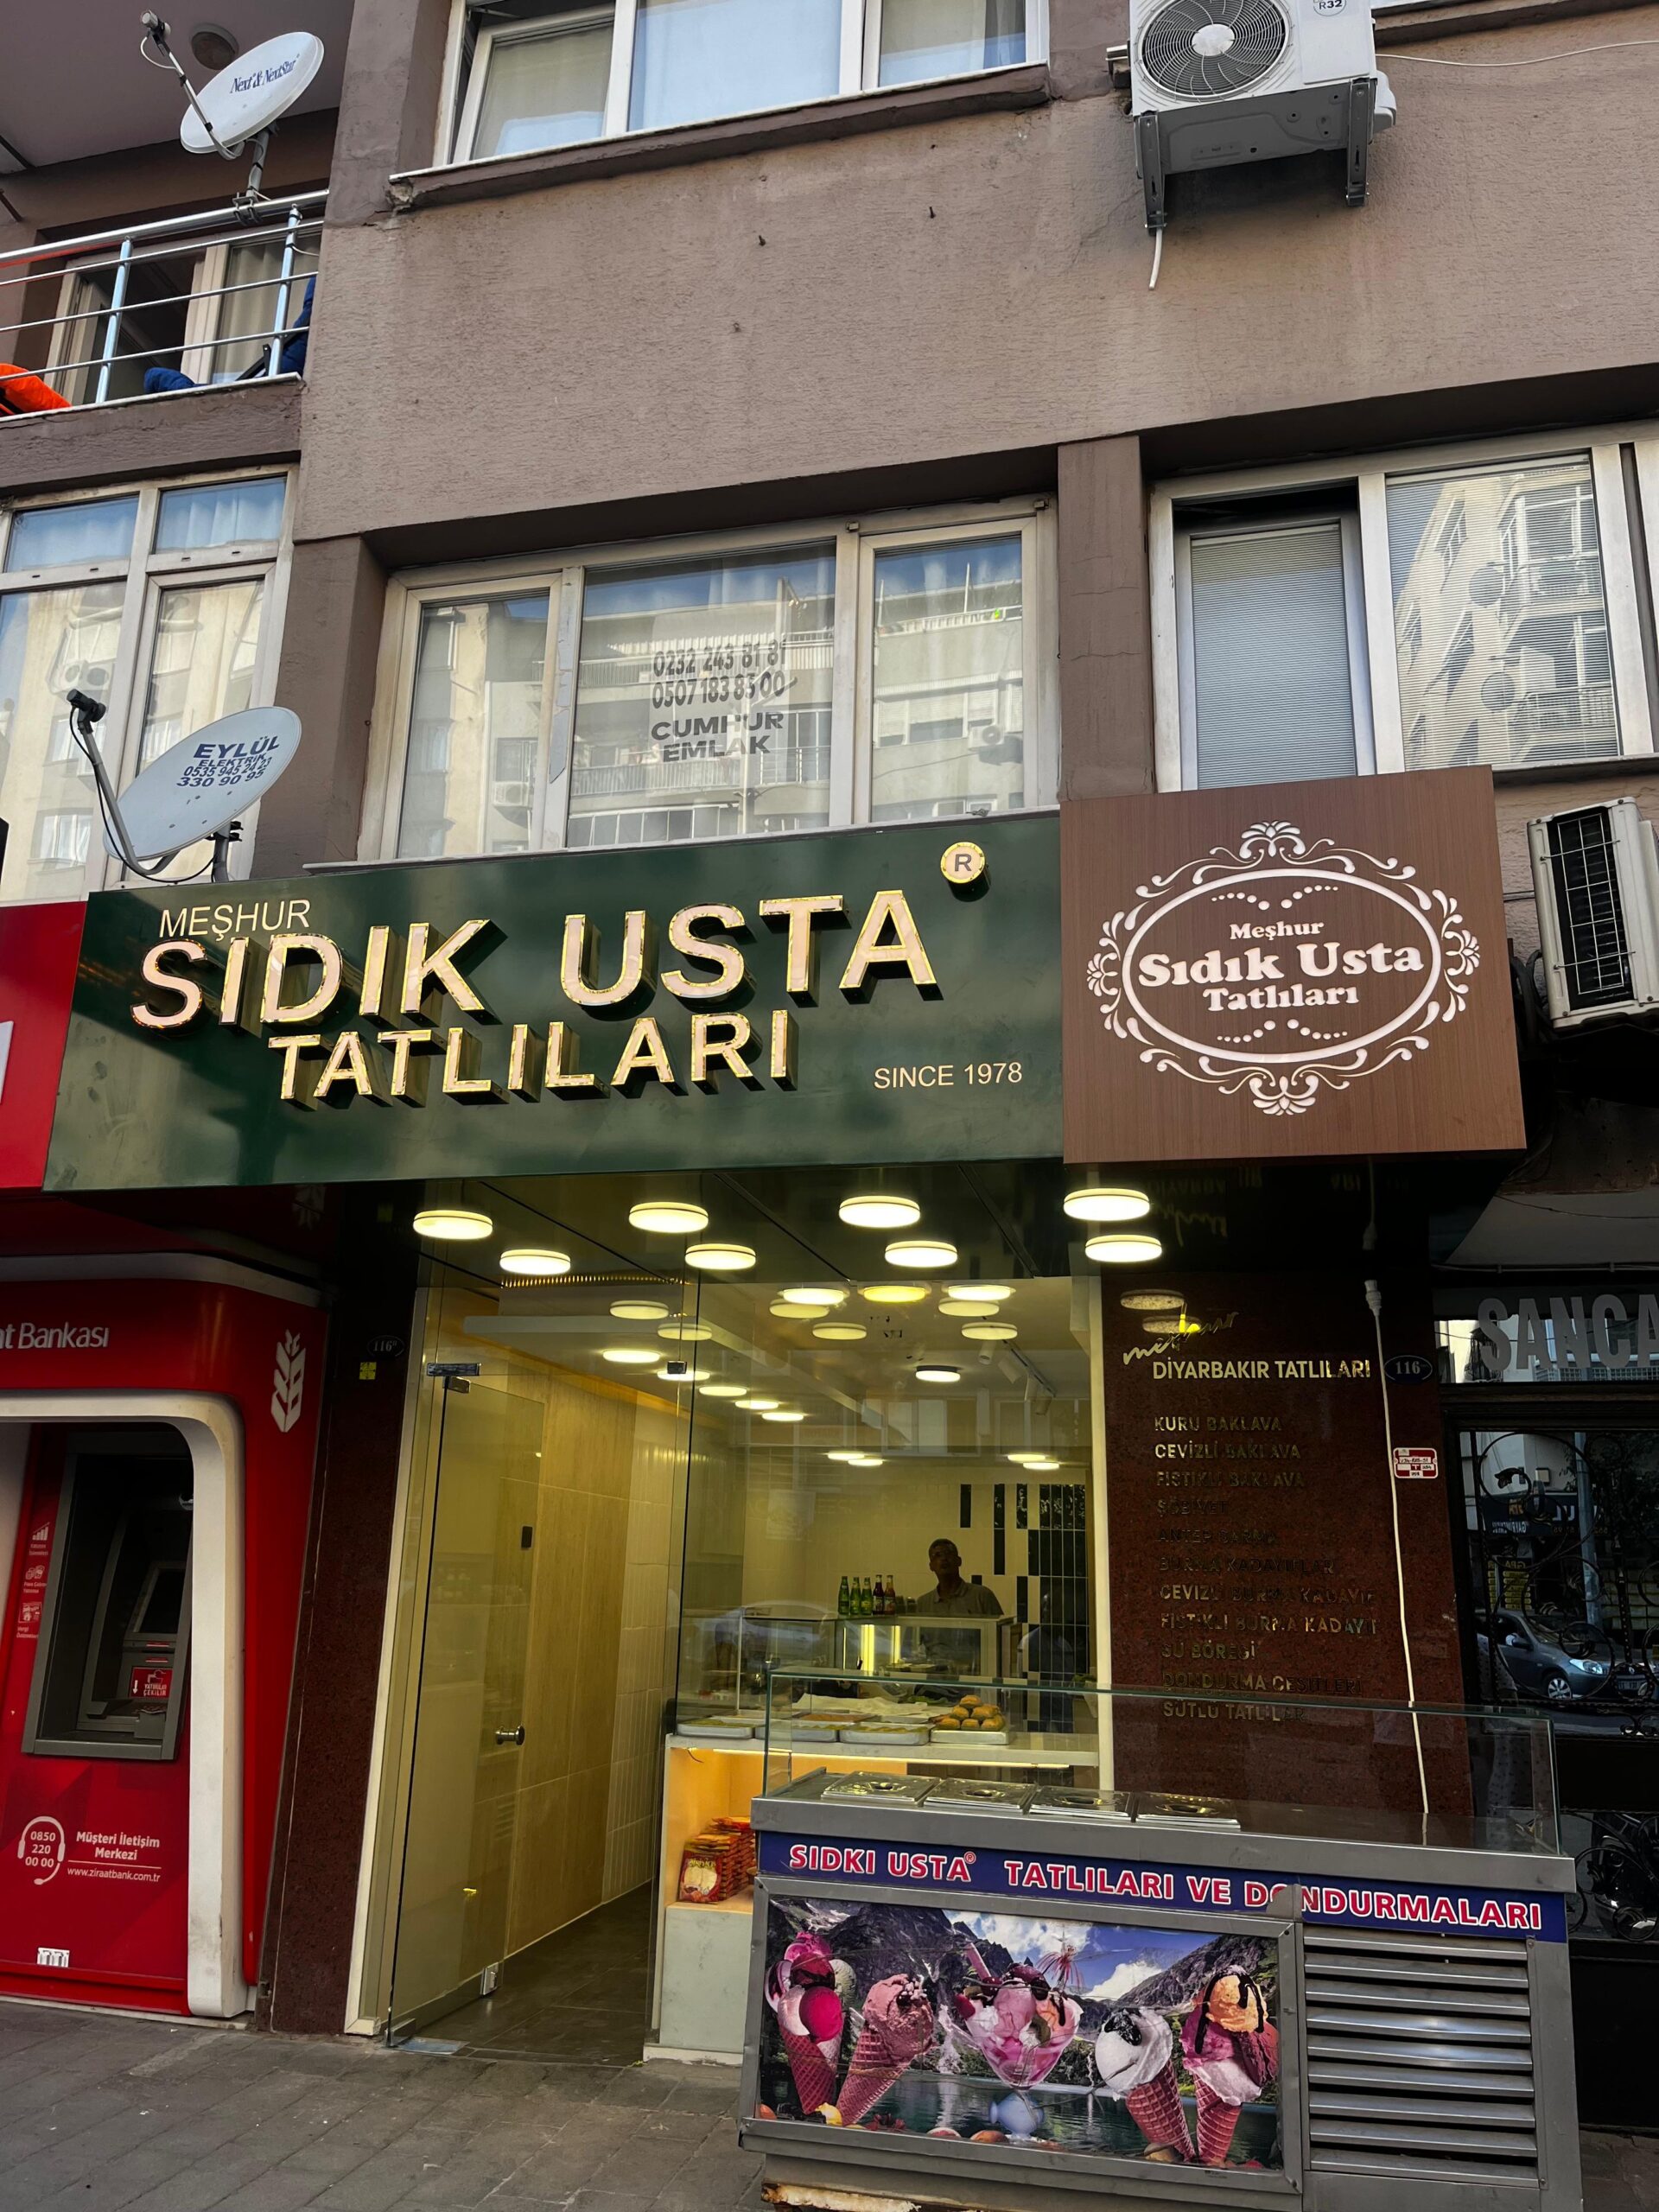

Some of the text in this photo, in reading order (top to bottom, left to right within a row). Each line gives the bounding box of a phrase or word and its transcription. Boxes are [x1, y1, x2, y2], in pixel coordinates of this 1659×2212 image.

[653, 647, 696, 677] 0232
[652, 678, 697, 709] 0507
[700, 676, 729, 703] 183
[760, 671, 785, 698] 00
[194, 736, 279, 758] EYLÜL
[663, 735, 771, 763] EMLAK
[176, 768, 264, 787] 330 90 95
[184, 766, 217, 777] 0535
[218, 766, 239, 776] 945
[241, 763, 256, 773] 24
[159, 899, 311, 942] MEŞHUR
[1229, 921, 1325, 941] Meşhur
[130, 919, 491, 1028] SIDIK
[560, 890, 938, 1006] USTA
[1138, 942, 1425, 987] Sıdık Usta
[1202, 983, 1359, 1012] Tatlıları
[268, 1010, 789, 1100] TATLILARI
[874, 1062, 1023, 1090] SINCE 1978
[18, 1322, 110, 1349] Bankası
[1153, 1357, 1371, 1380] DİYARBAKIR TATLILARI
[1154, 1416, 1282, 1432] KURU BAKLAVA
[1154, 1440, 1218, 1459] CEVİZLİ
[1162, 1699, 1219, 1719] SÜTLÜ
[30, 1831, 56, 1842] 0850
[76, 1831, 160, 1848] Müşteri İletişim
[31, 1844, 51, 1854] 220
[95, 1847, 137, 1860] Merkezi
[25, 1857, 54, 1867] 00 00
[67, 1867, 162, 1882] www.ziraatbank.com.tr
[789, 1844, 876, 1875] SIDKI
[1004, 1859, 1174, 1900] TATLILARI
[1185, 1875, 1231, 1905] VE
